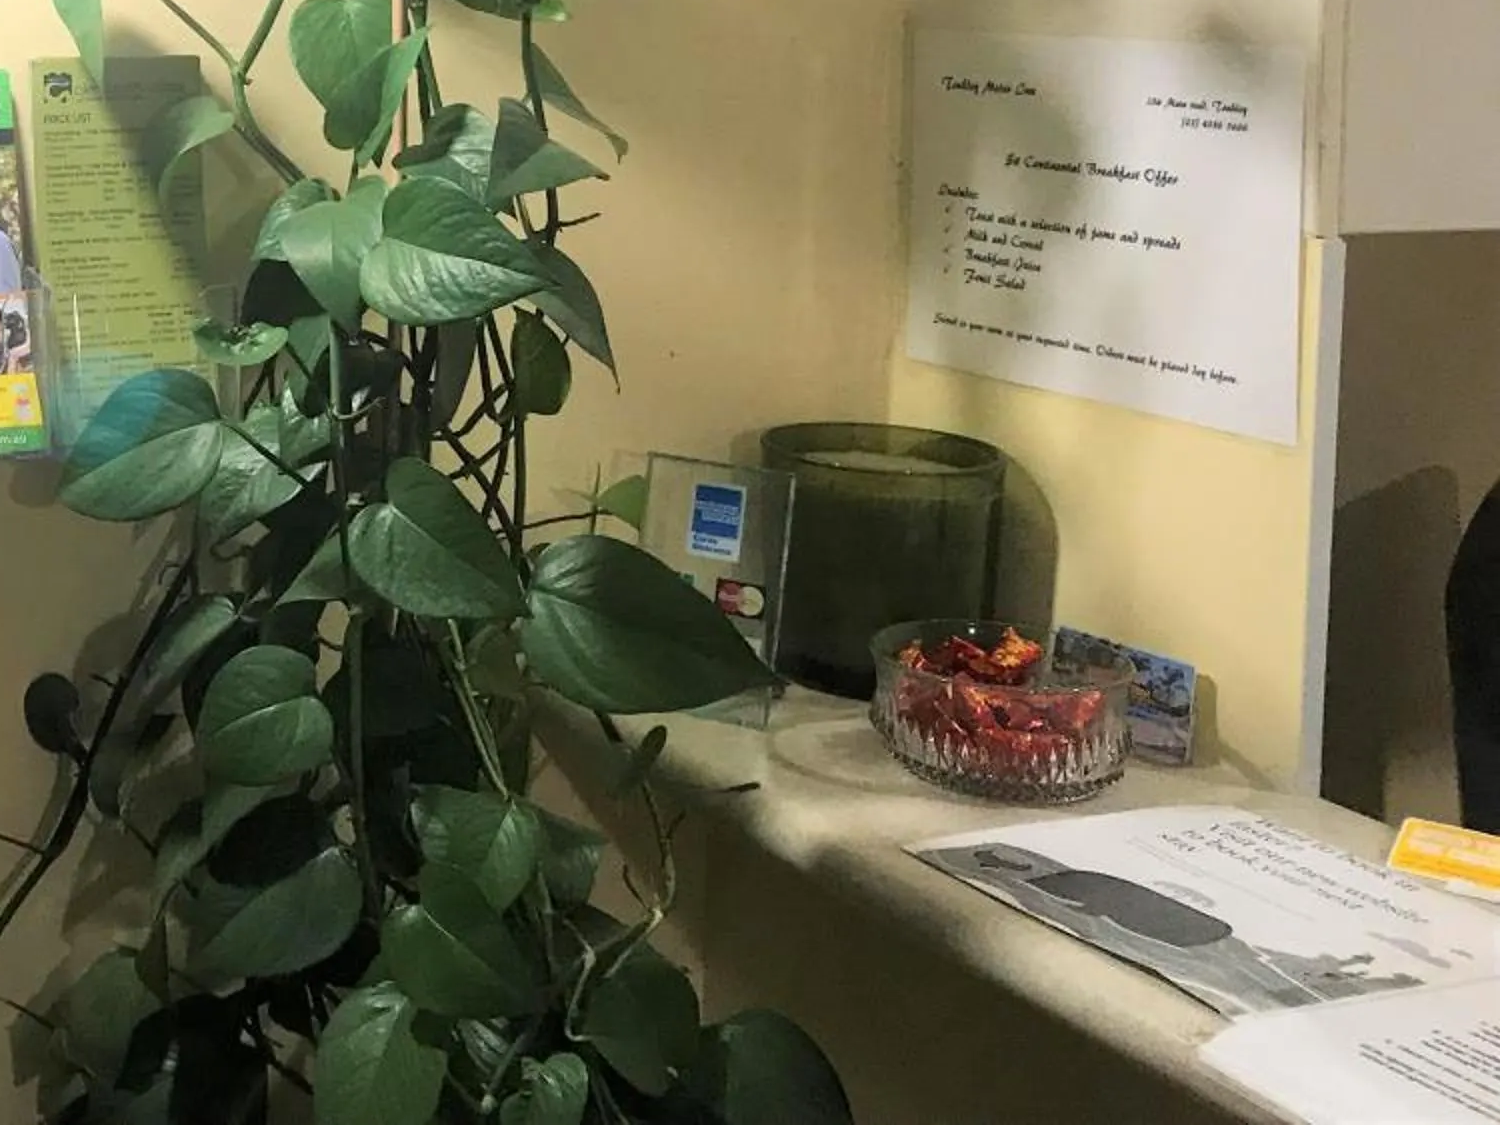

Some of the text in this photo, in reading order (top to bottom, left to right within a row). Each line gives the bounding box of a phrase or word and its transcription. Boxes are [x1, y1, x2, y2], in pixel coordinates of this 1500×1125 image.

[1086, 162, 1139, 183] Breakfast
[1143, 168, 1179, 187] Offer
[1119, 230, 1138, 244] and
[1142, 236, 1181, 251] spreads
